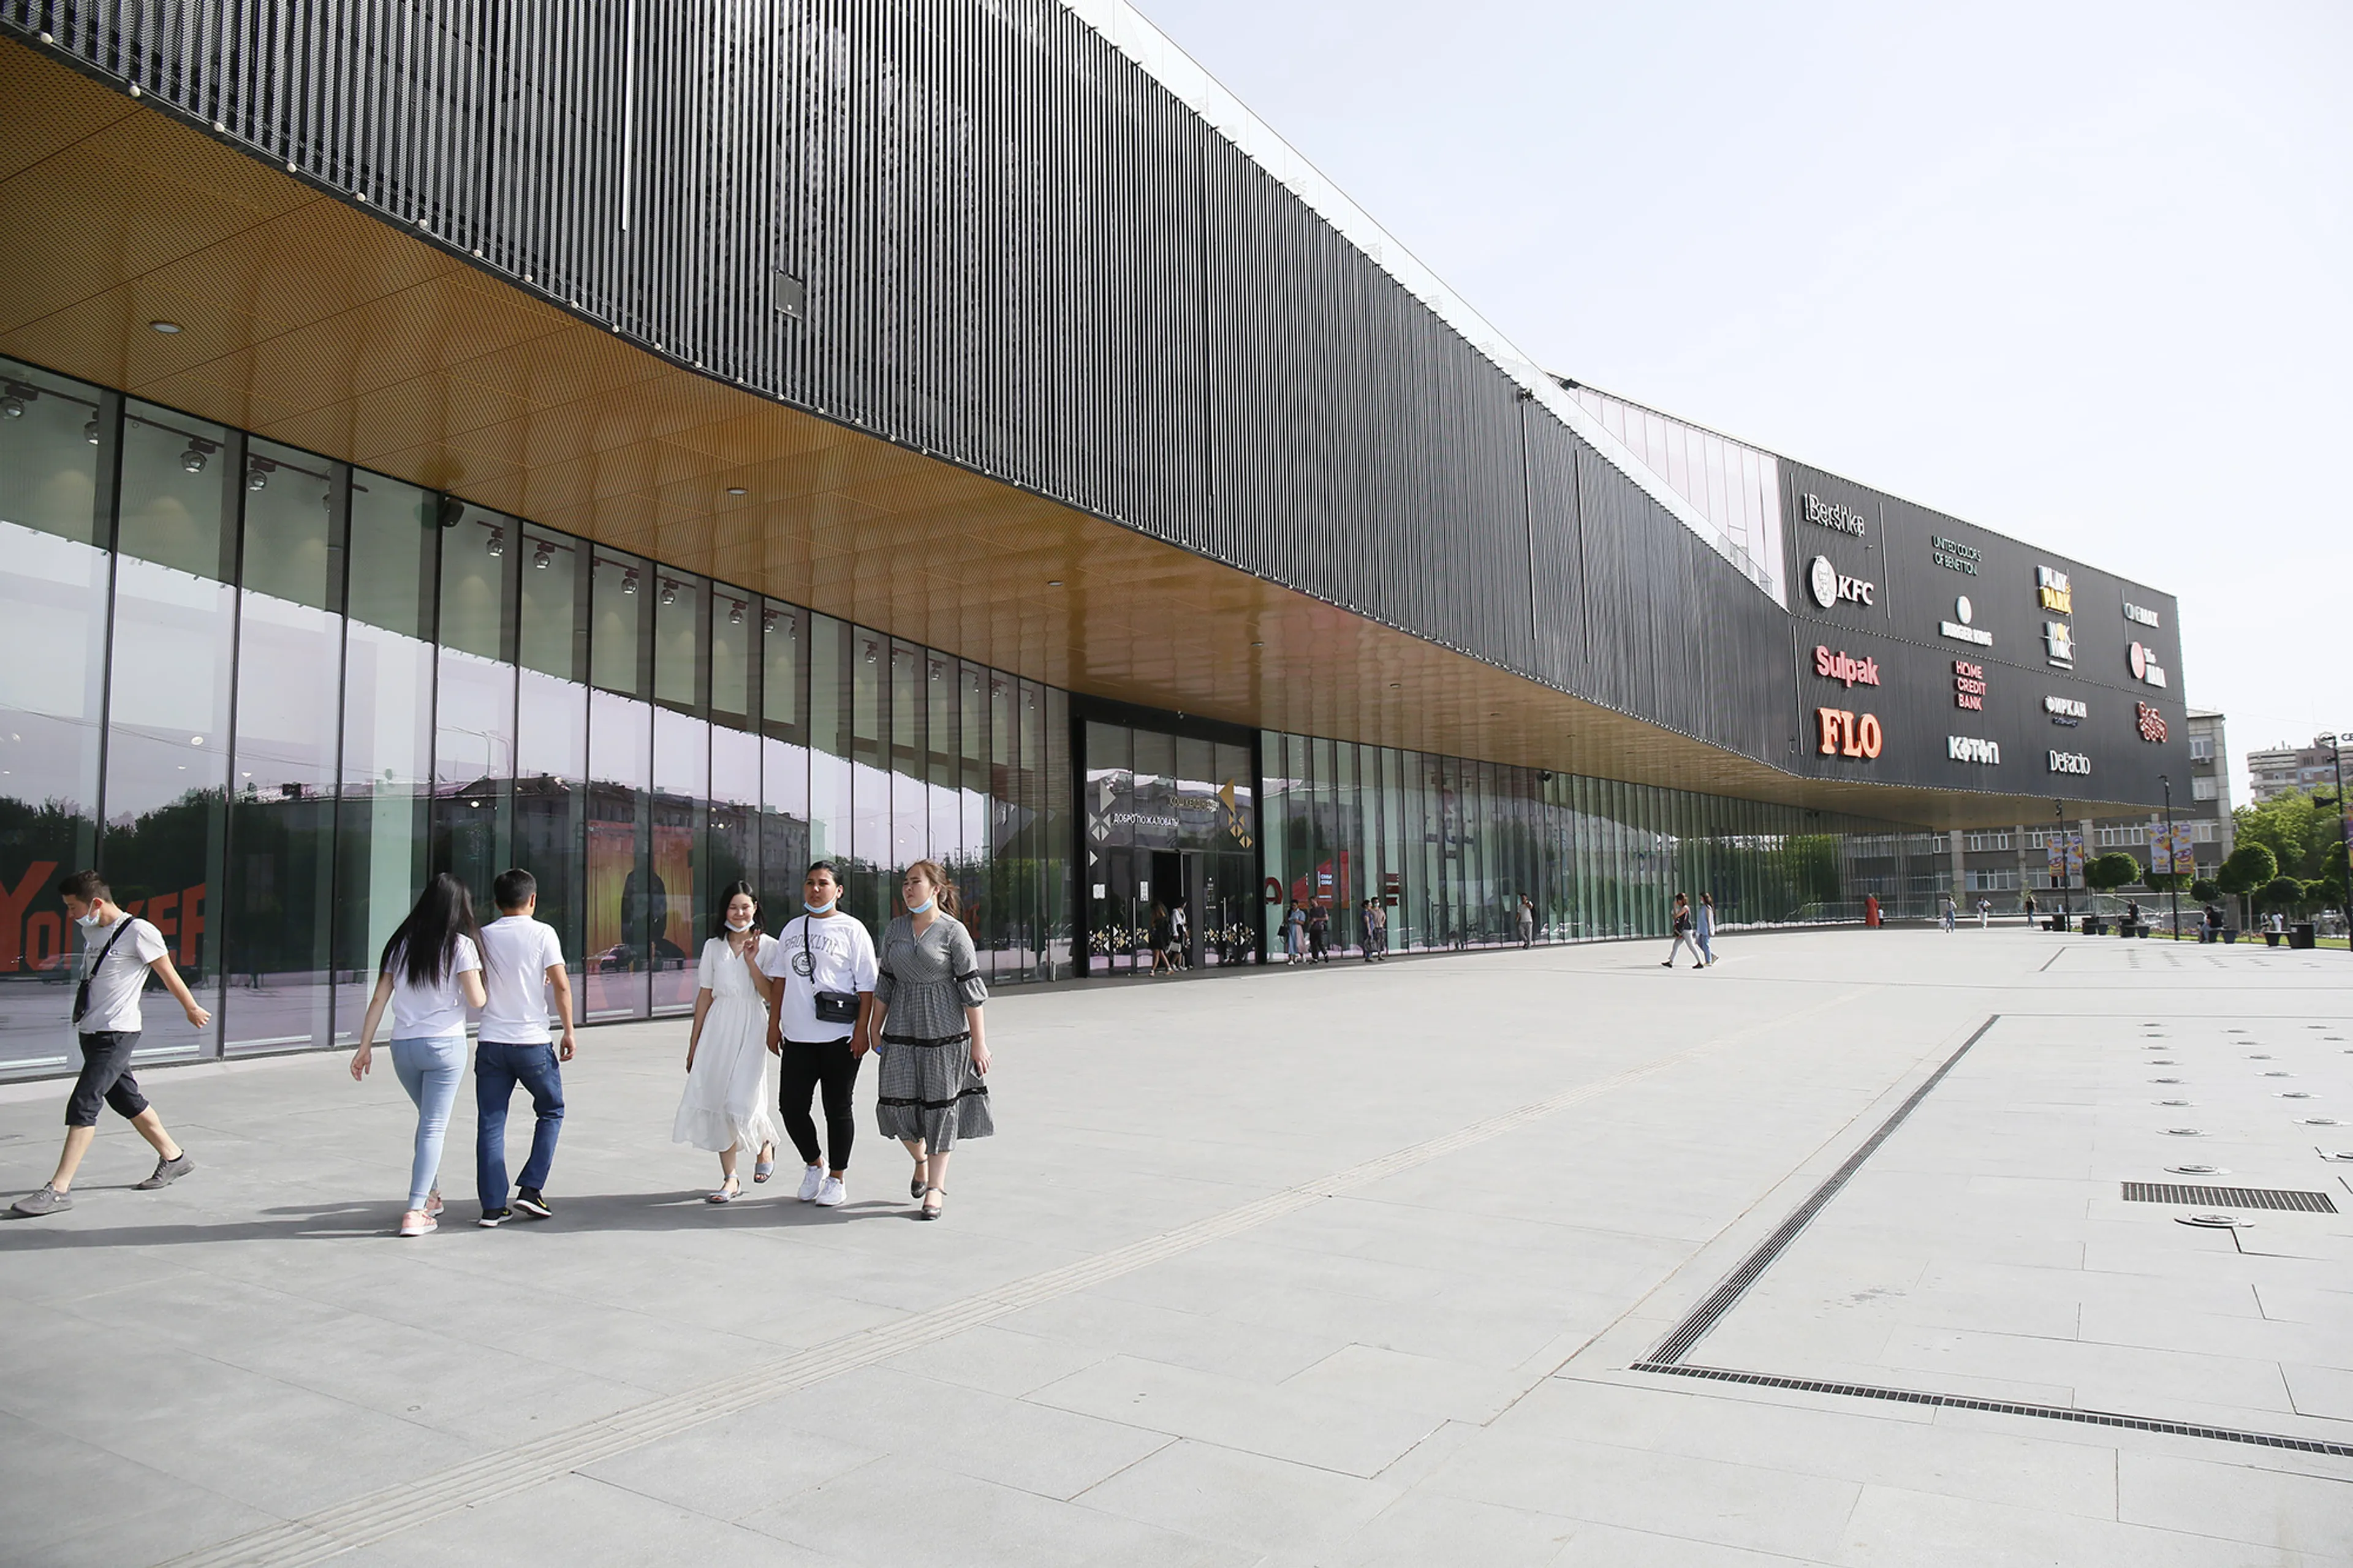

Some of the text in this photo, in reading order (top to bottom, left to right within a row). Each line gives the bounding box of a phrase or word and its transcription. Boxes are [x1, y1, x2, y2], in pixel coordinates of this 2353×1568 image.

[1804, 493, 1865, 537] Bershka
[1933, 535, 1981, 562] UNITED COLORS
[1934, 552, 1944, 565] OF
[1837, 575, 1874, 605] KFC
[2040, 586, 2073, 614] PARK
[1816, 645, 1881, 688] Sulpak
[1956, 660, 1983, 679] HOME
[1957, 677, 1987, 696] CREDIT
[1958, 693, 1983, 711] BANK
[1817, 707, 1882, 759] FLO
[2049, 749, 2091, 775] DeFacto
